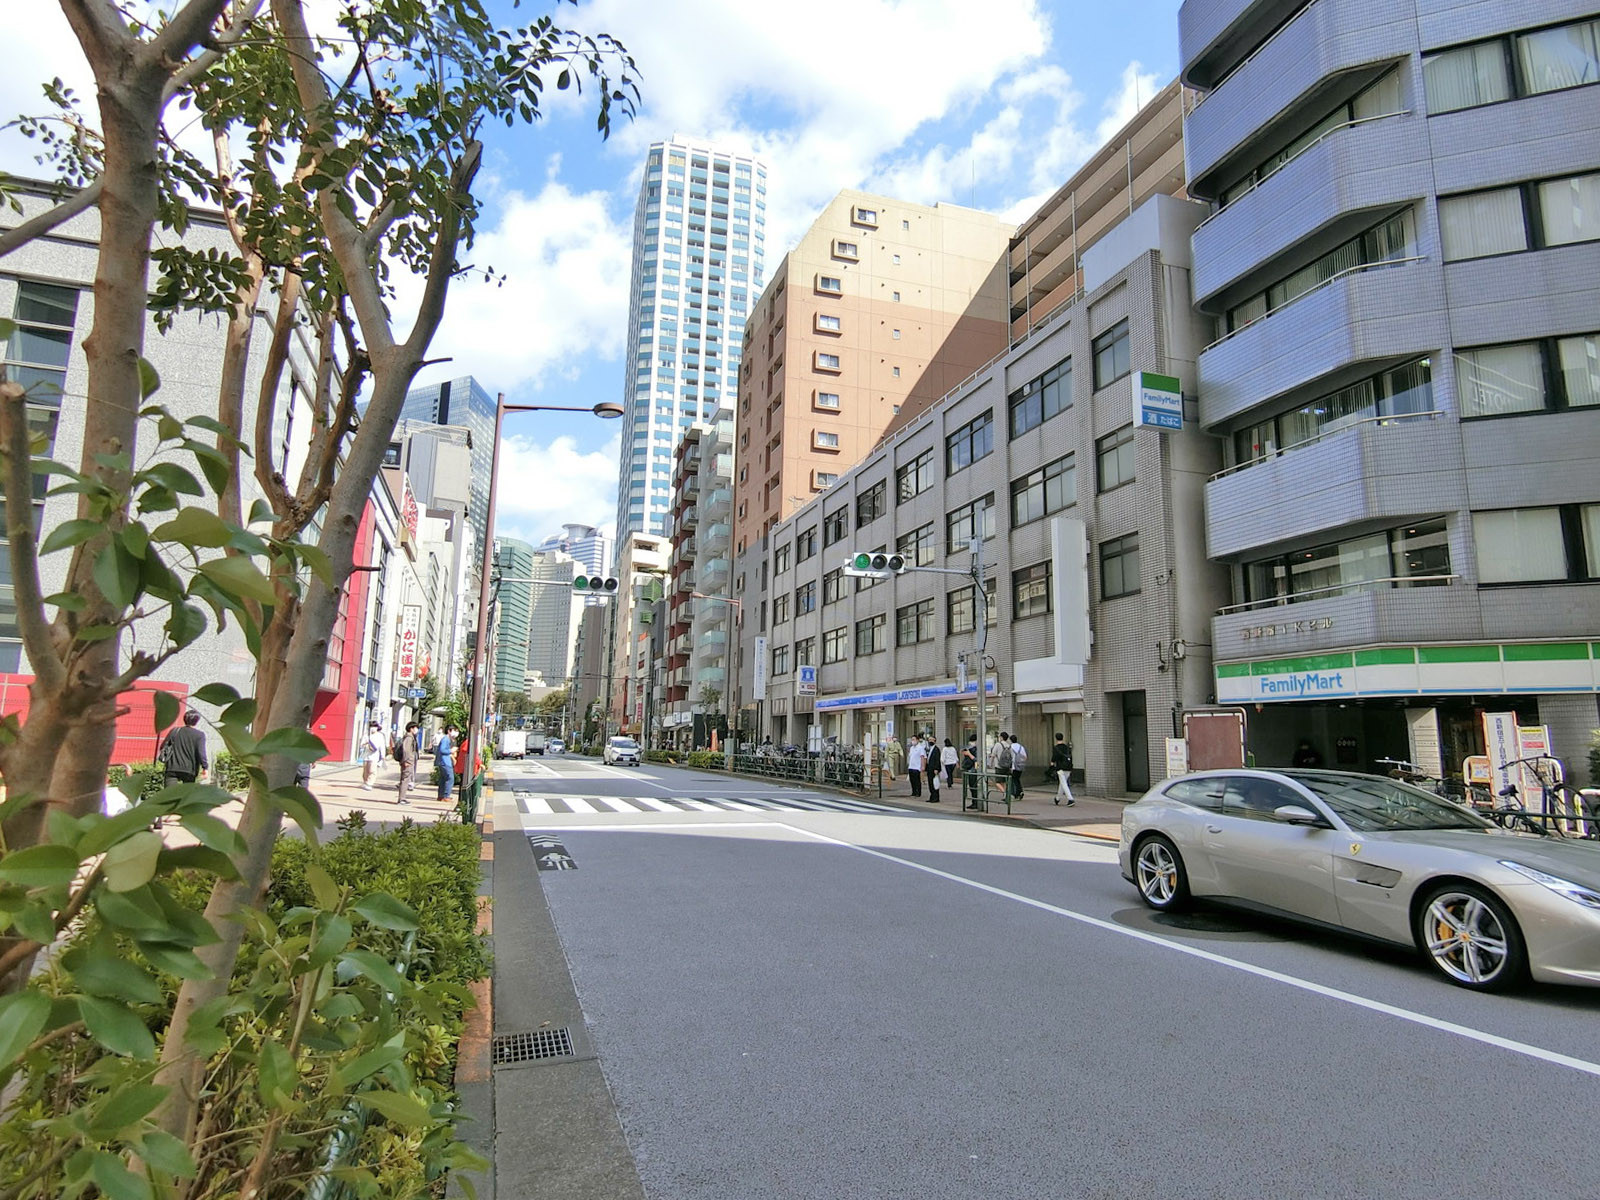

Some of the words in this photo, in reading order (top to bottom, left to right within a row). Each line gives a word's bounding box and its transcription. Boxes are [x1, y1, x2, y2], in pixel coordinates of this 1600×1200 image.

[1143, 392, 1180, 406] FamilyMart
[1147, 412, 1158, 424] 酒
[1160, 415, 1180, 426] たばこ
[400, 629, 417, 678] かに道楽
[1260, 672, 1343, 695] FamilyMart
[898, 689, 921, 700] LAWSON
